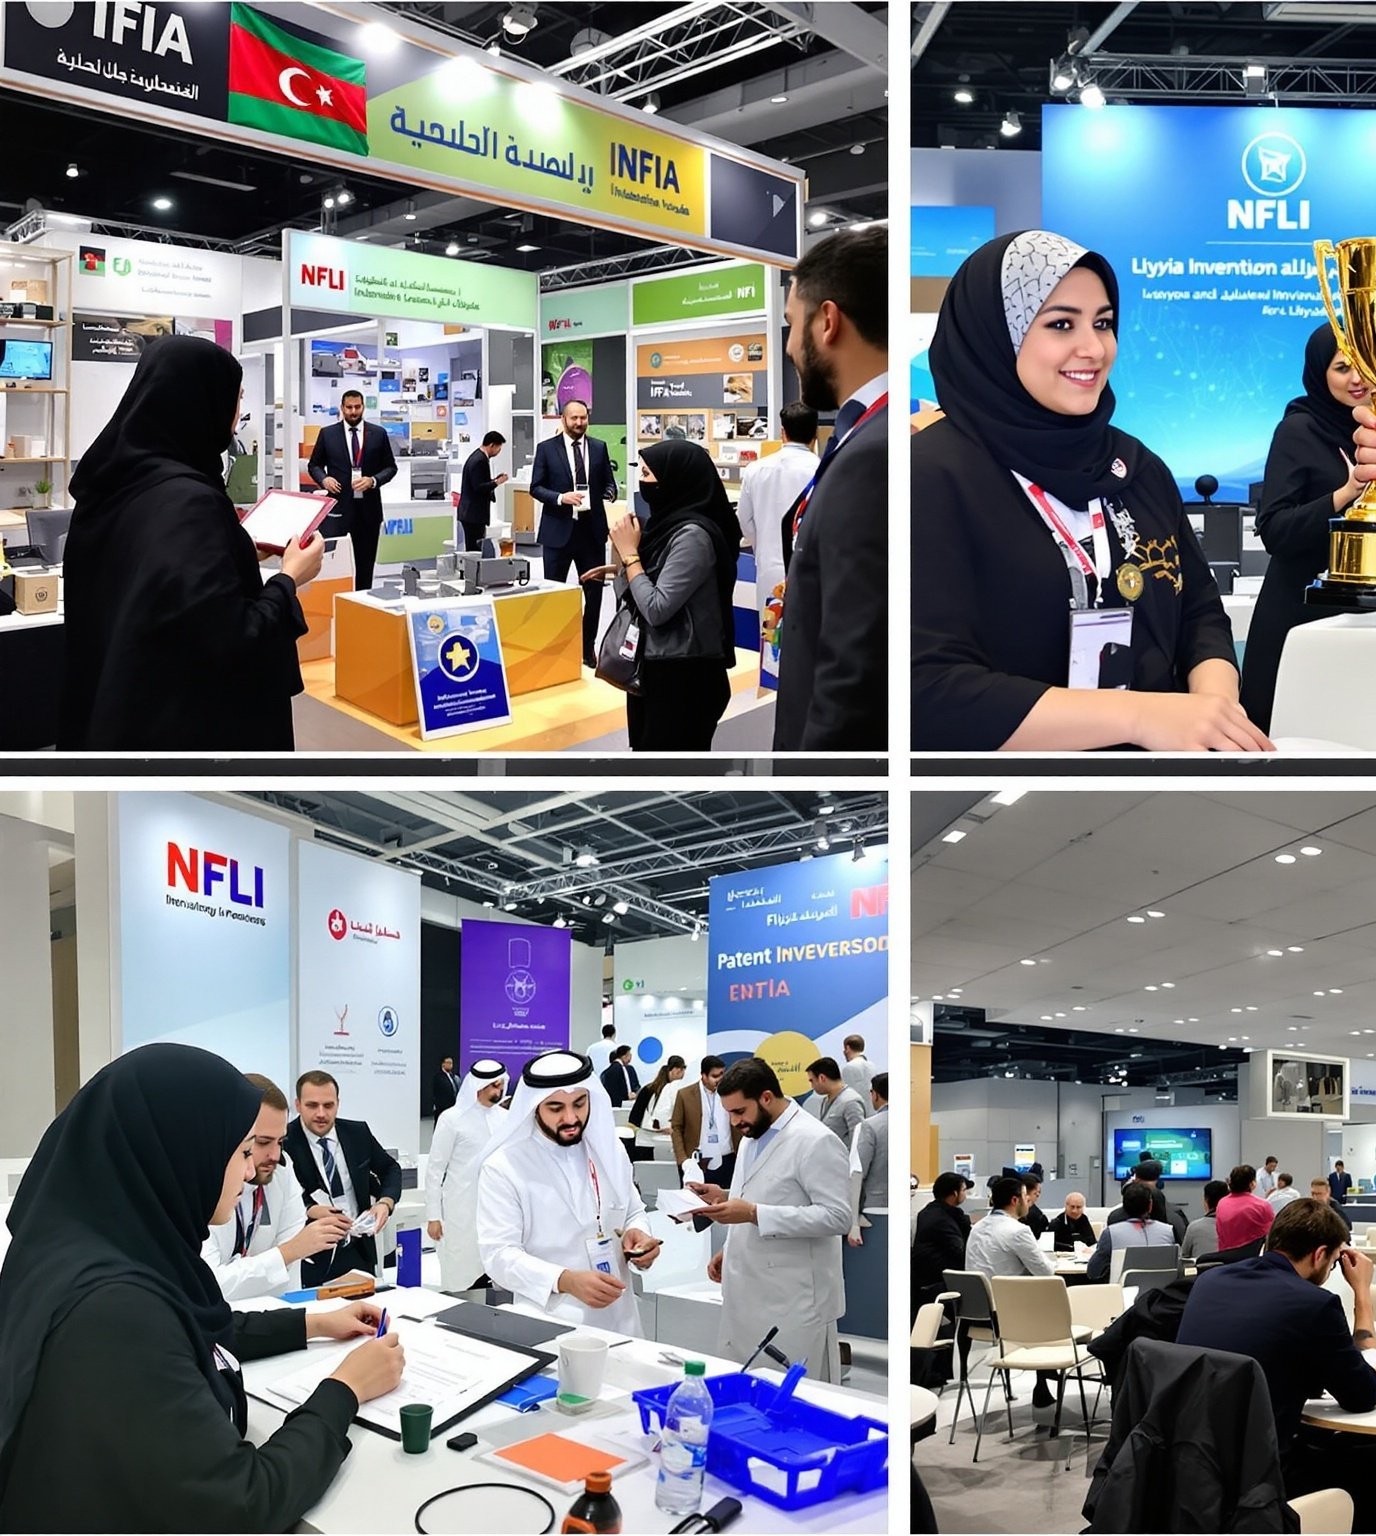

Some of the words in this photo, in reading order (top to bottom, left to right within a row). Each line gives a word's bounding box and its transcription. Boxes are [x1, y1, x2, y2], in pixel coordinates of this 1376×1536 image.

[93, 1, 193, 65] IFIA
[611, 142, 680, 194] INFIA
[1227, 200, 1310, 230] NFLI
[301, 263, 345, 291] NFLI
[1189, 258, 1277, 276] Invention
[167, 841, 264, 909] NFLI
[717, 948, 773, 970] Patent
[729, 978, 791, 1002] ENTIA
